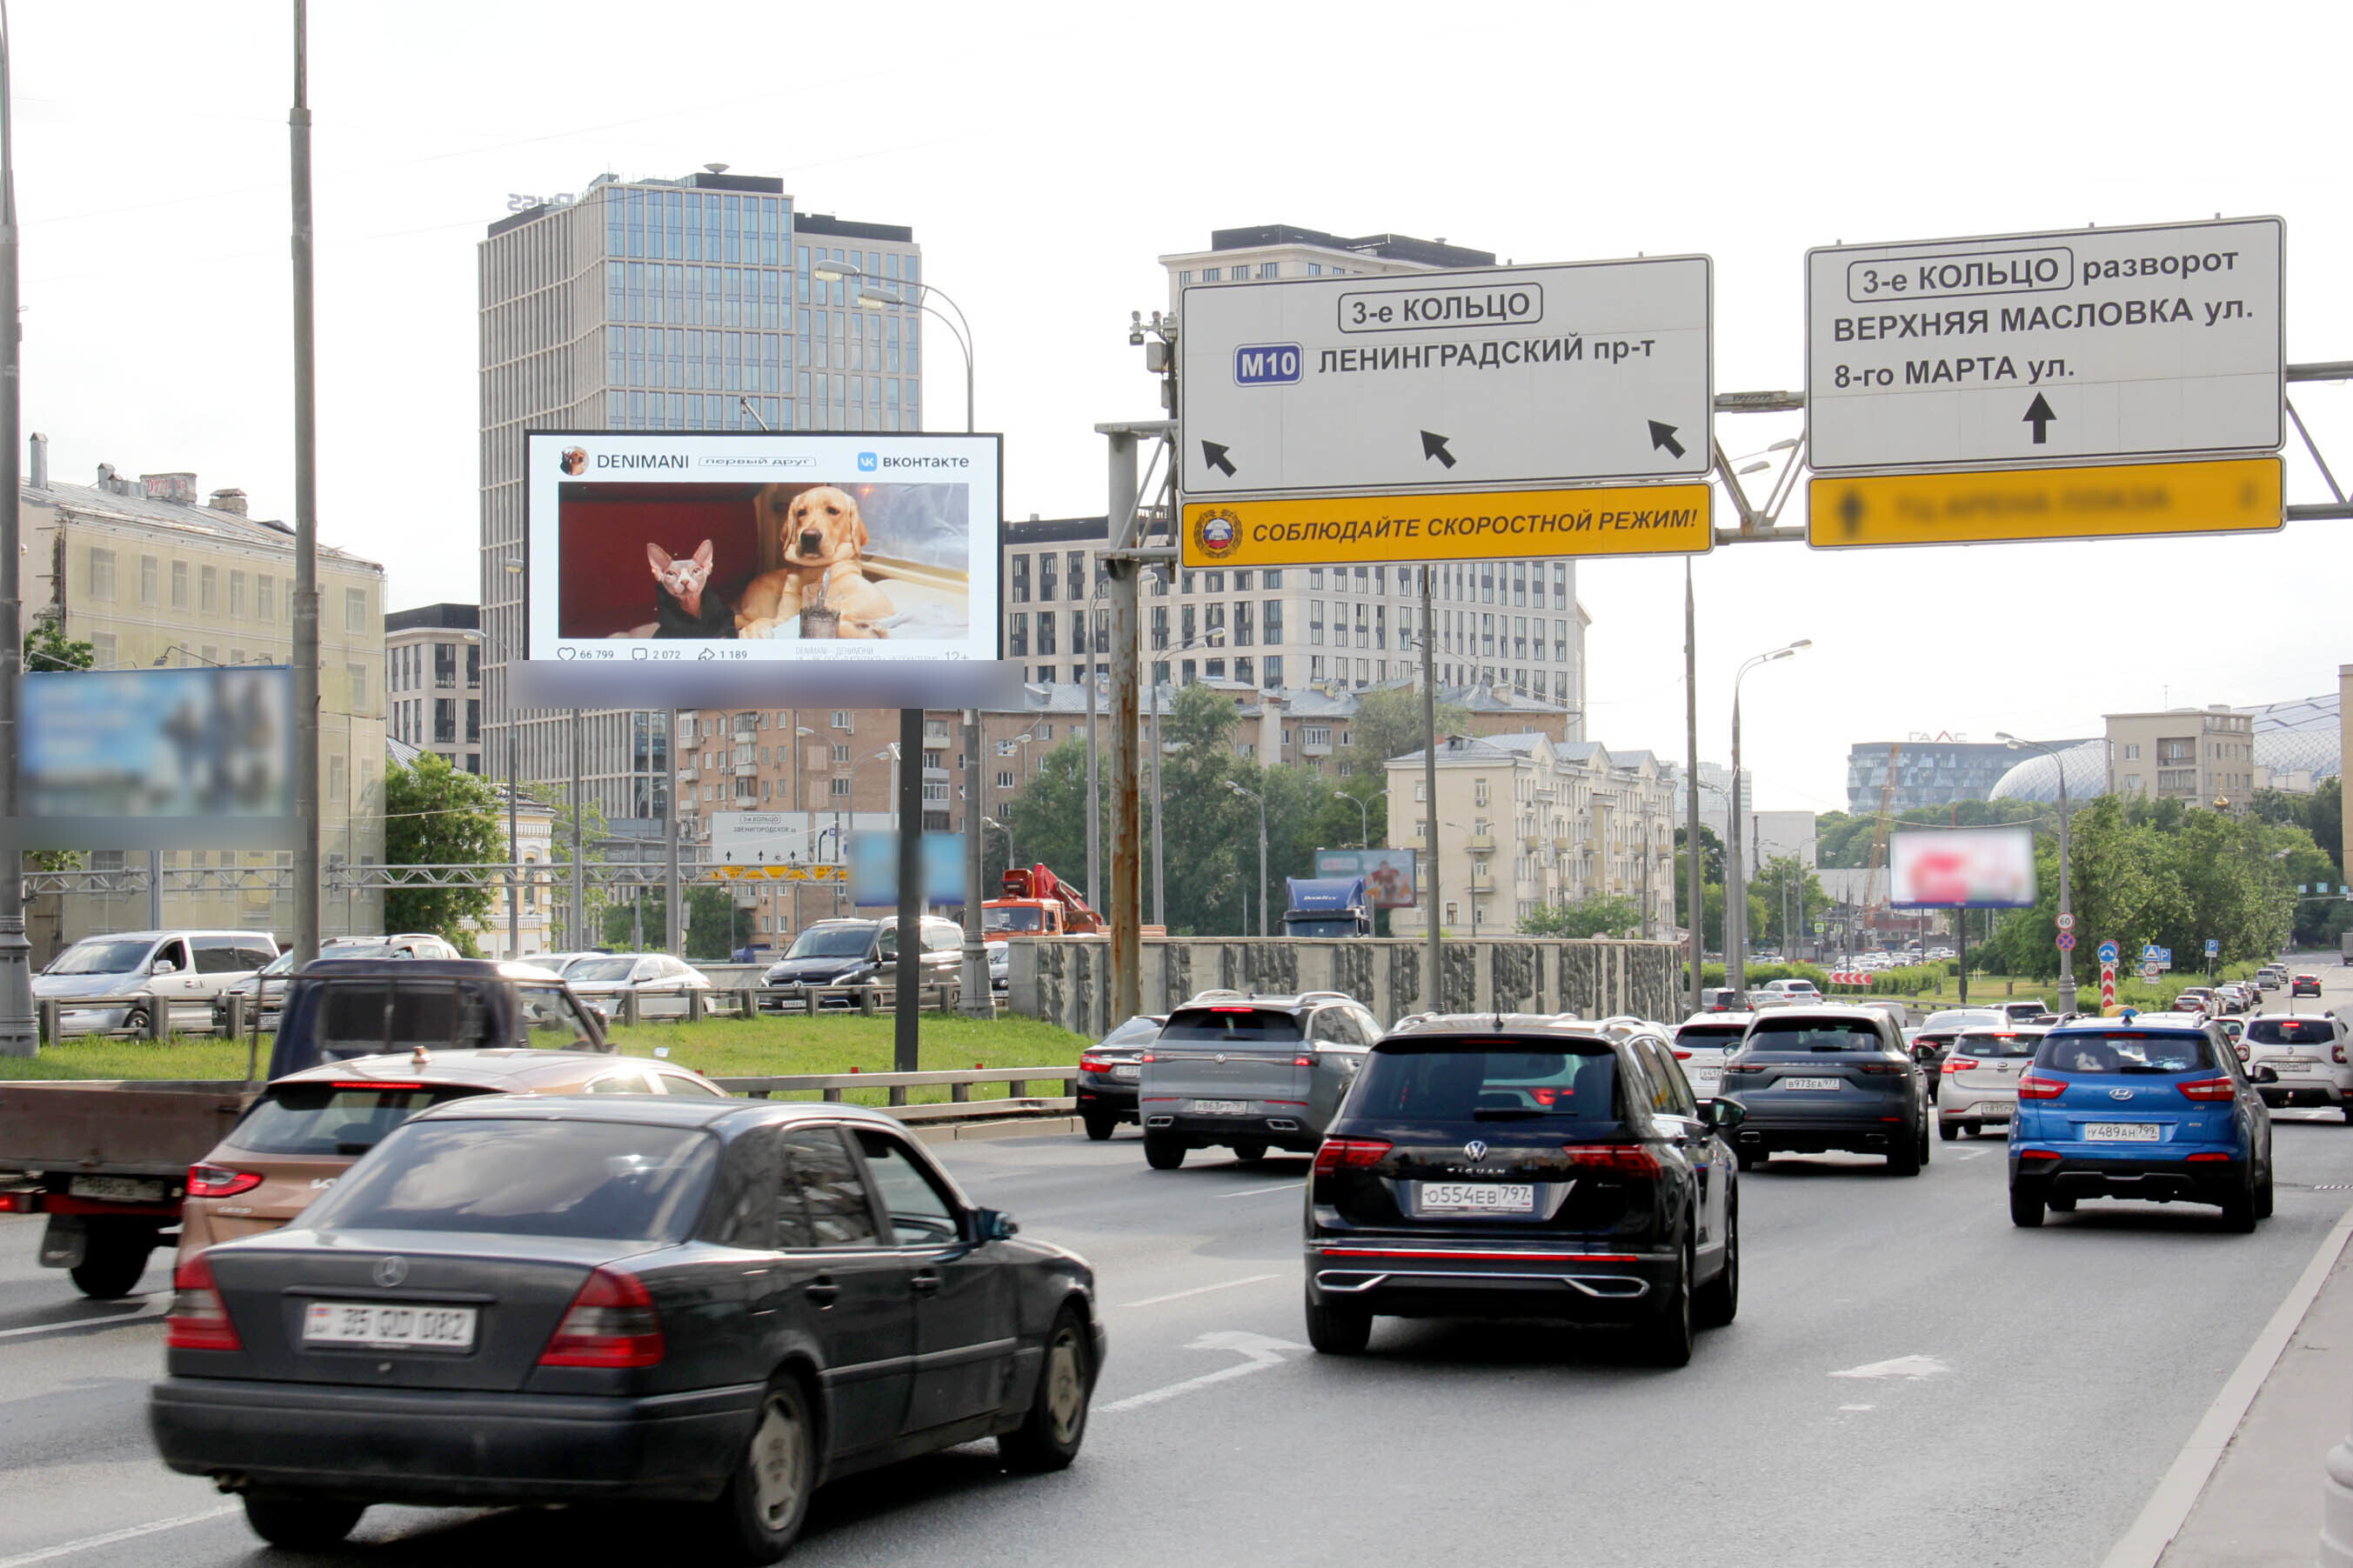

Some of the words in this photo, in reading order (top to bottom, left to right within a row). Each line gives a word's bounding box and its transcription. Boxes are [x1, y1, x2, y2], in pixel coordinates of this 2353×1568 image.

[1863, 270, 1908, 294] 3-е
[1919, 257, 2059, 290] КОЛЬЦО
[2083, 251, 2238, 285] разворот
[1352, 301, 1394, 324] 3-е
[1403, 292, 1530, 324] КОЛЬЦО
[1834, 310, 1989, 342] ВЕРХНЯЯ
[2000, 297, 2193, 332] МАСЛОВКА
[2203, 299, 2253, 328] ул.
[1240, 352, 1297, 377] М10
[1319, 331, 1583, 374] ЛЕНИНГРАДСКИЙ
[1594, 337, 1656, 365] пр-т
[1834, 364, 1895, 389] 8-го
[1905, 356, 2017, 384] МАРТА
[2028, 357, 2075, 385] ул.
[598, 455, 688, 469] DENIMANI
[705, 457, 767, 466] первый
[772, 457, 810, 466] друг
[883, 457, 969, 468] вконтакте
[1253, 516, 1420, 545] СОБЛЮДАЙТЕ
[1427, 509, 1593, 540] СКОРОСТНОЙ
[1598, 509, 1698, 531] РЕЖИМ!
[580, 651, 592, 659] 66
[597, 651, 614, 659] 799
[653, 651, 658, 659] 2
[662, 651, 680, 659] 072
[730, 651, 747, 659] 189
